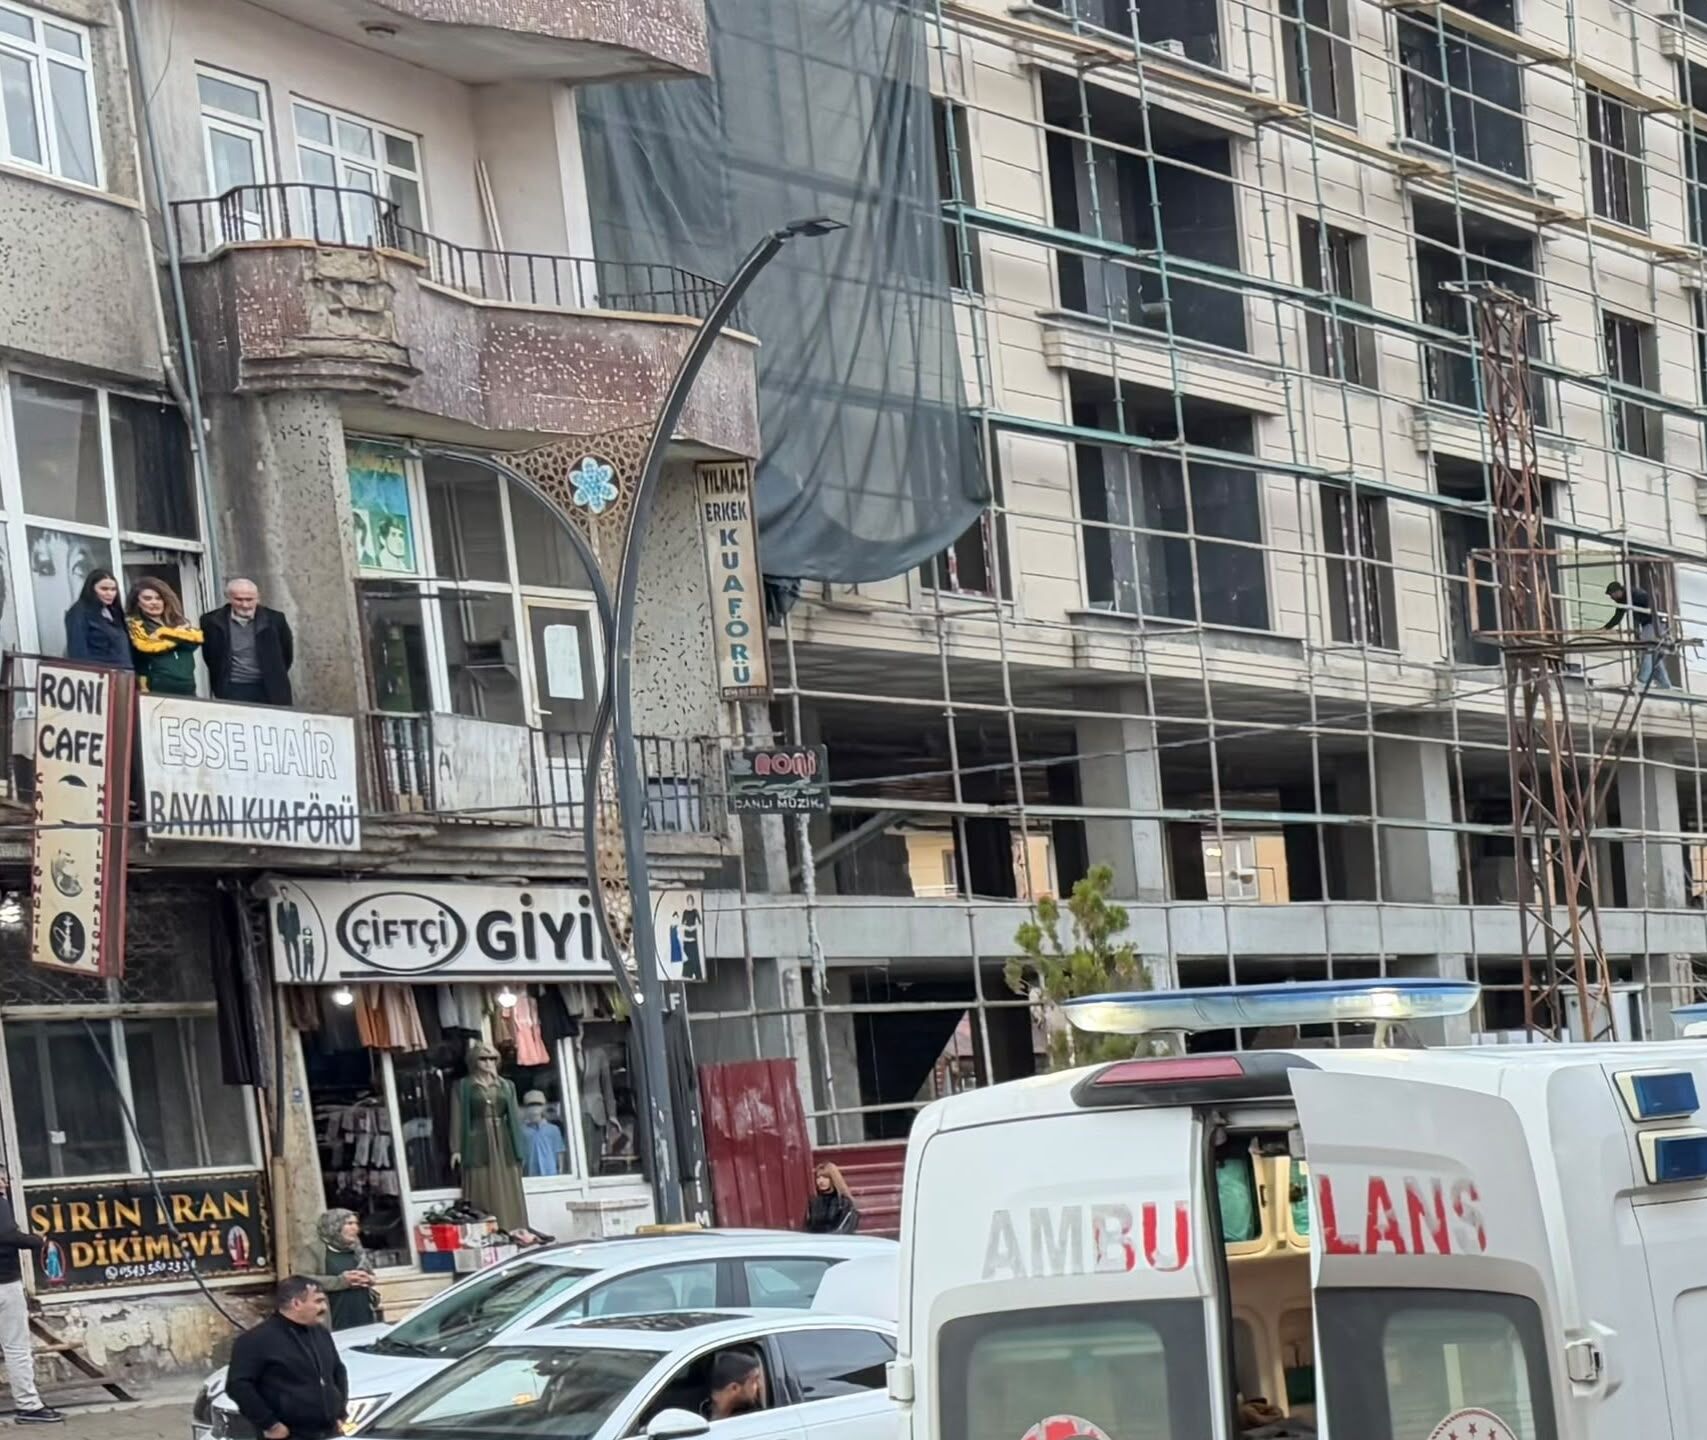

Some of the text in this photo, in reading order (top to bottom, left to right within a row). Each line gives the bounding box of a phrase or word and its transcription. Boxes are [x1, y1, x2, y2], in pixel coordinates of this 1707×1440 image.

[703, 467, 747, 495] YILMAZ
[705, 500, 748, 522] ERKEK
[718, 527, 753, 684] KUAFÖRÜ
[39, 724, 105, 768] CAFE
[160, 716, 337, 780] ESSE HAİR
[150, 790, 355, 847] BAYAN KUAFÖRÜ
[351, 892, 606, 963] ÇİFTÇİ GİYİ
